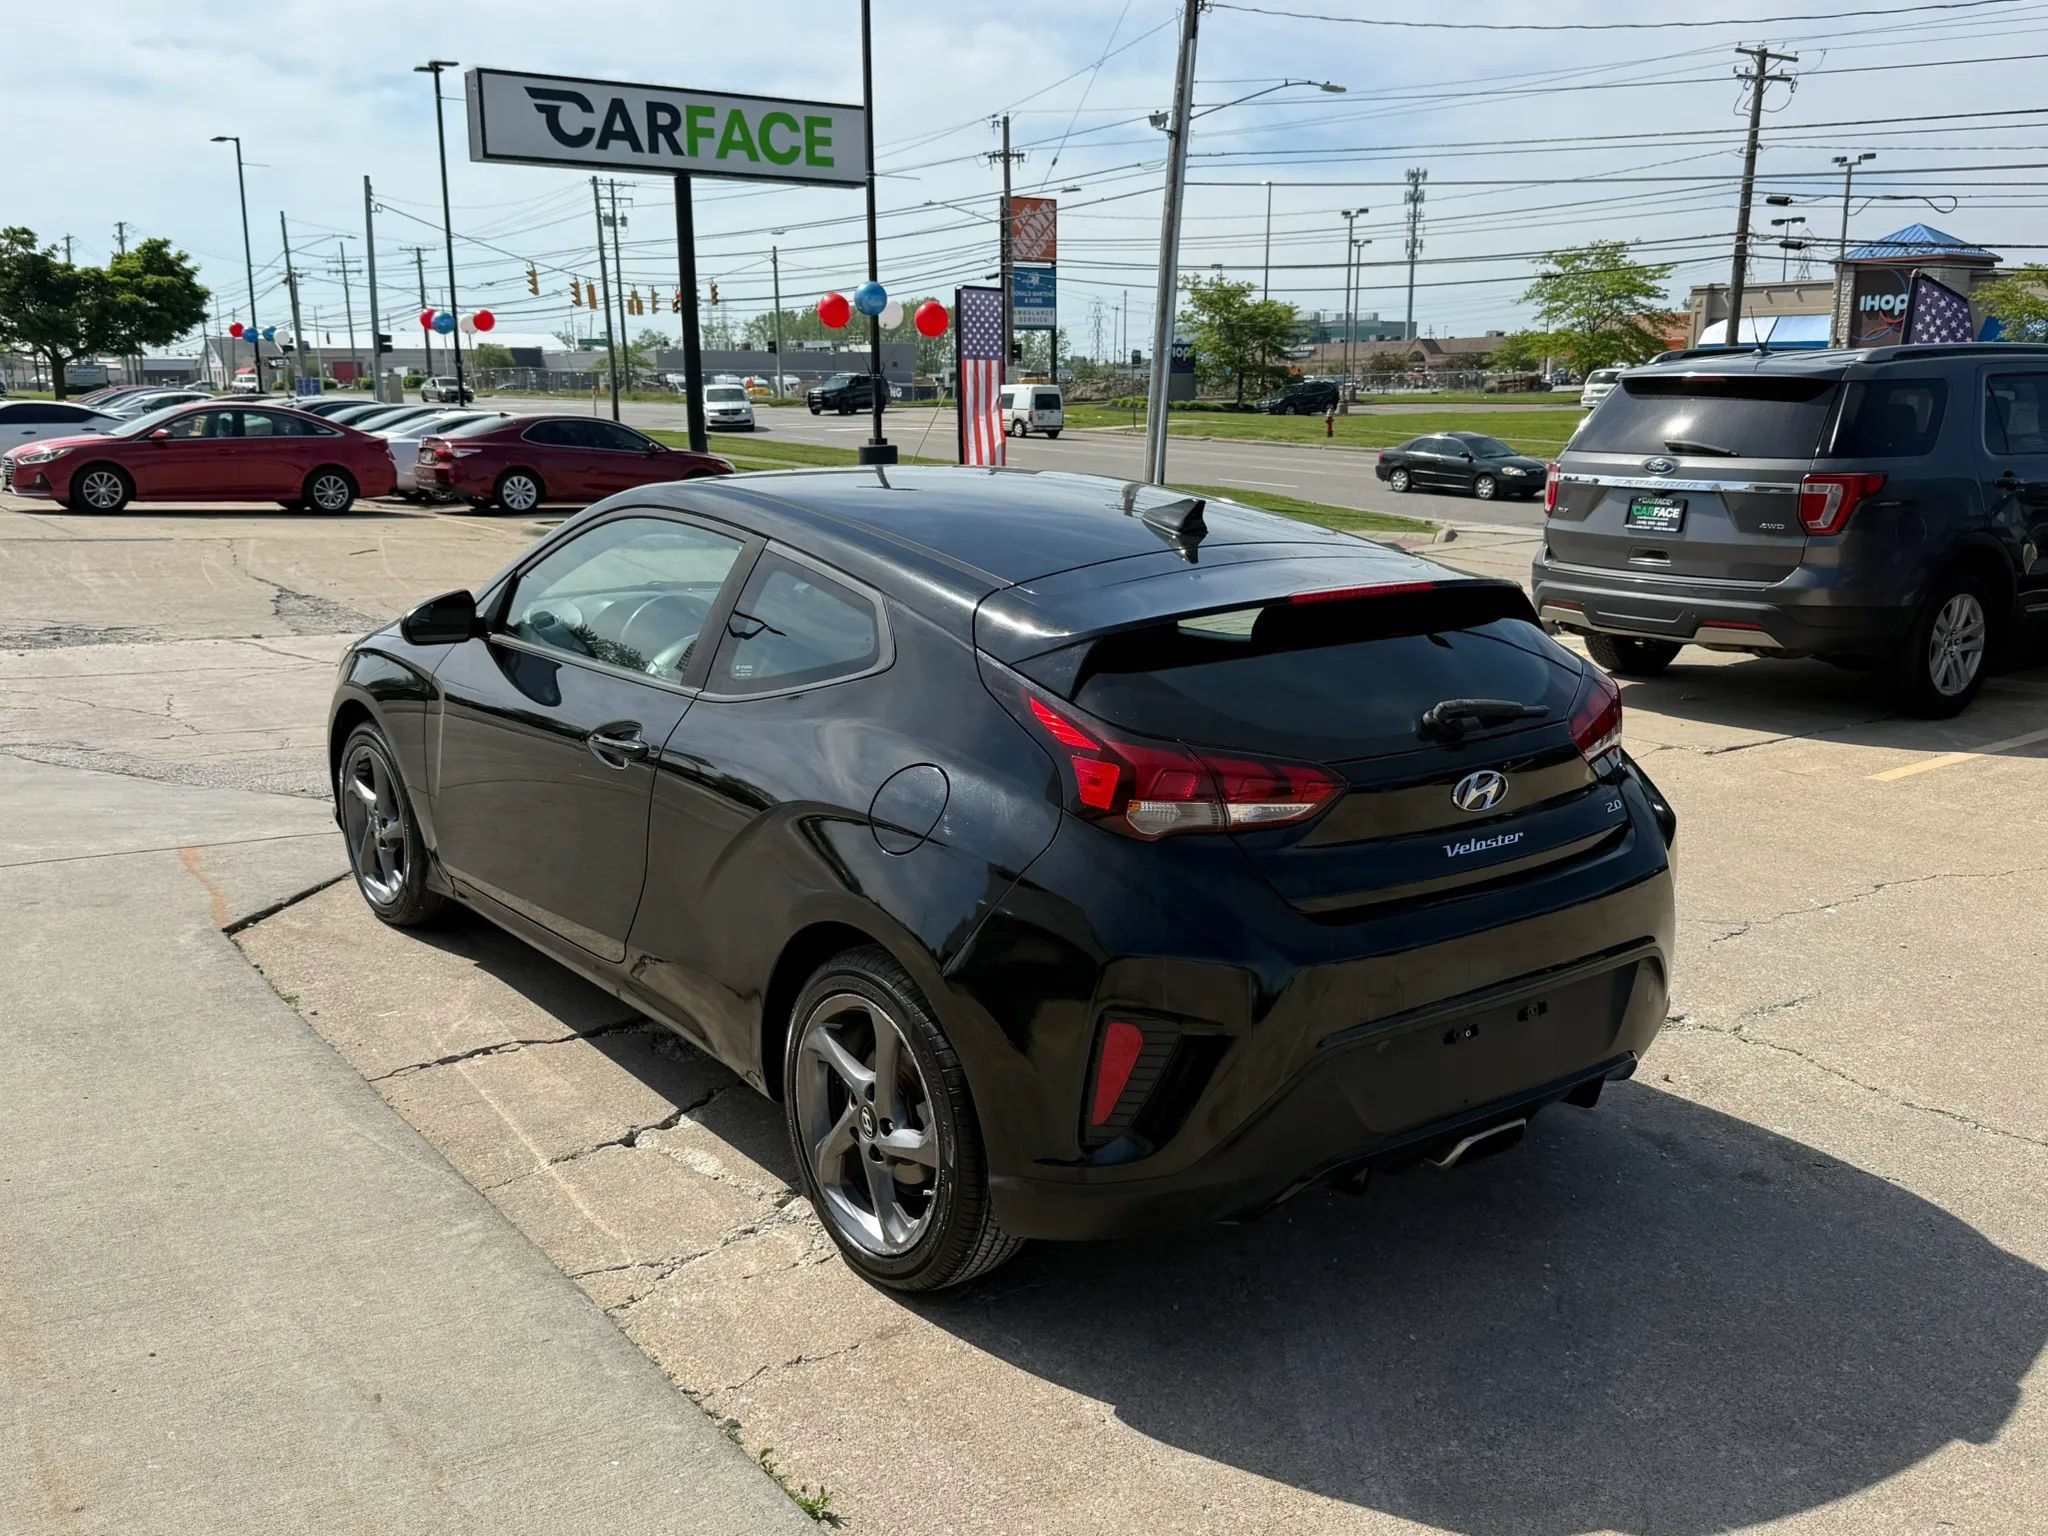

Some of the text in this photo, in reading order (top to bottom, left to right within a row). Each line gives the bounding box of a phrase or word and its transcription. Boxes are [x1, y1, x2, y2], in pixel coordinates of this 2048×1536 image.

[523, 86, 835, 168] CARFACE
[1859, 293, 1908, 316] IHOP
[1632, 505, 1680, 518] CARFACE
[1442, 831, 1524, 858] Veloster
